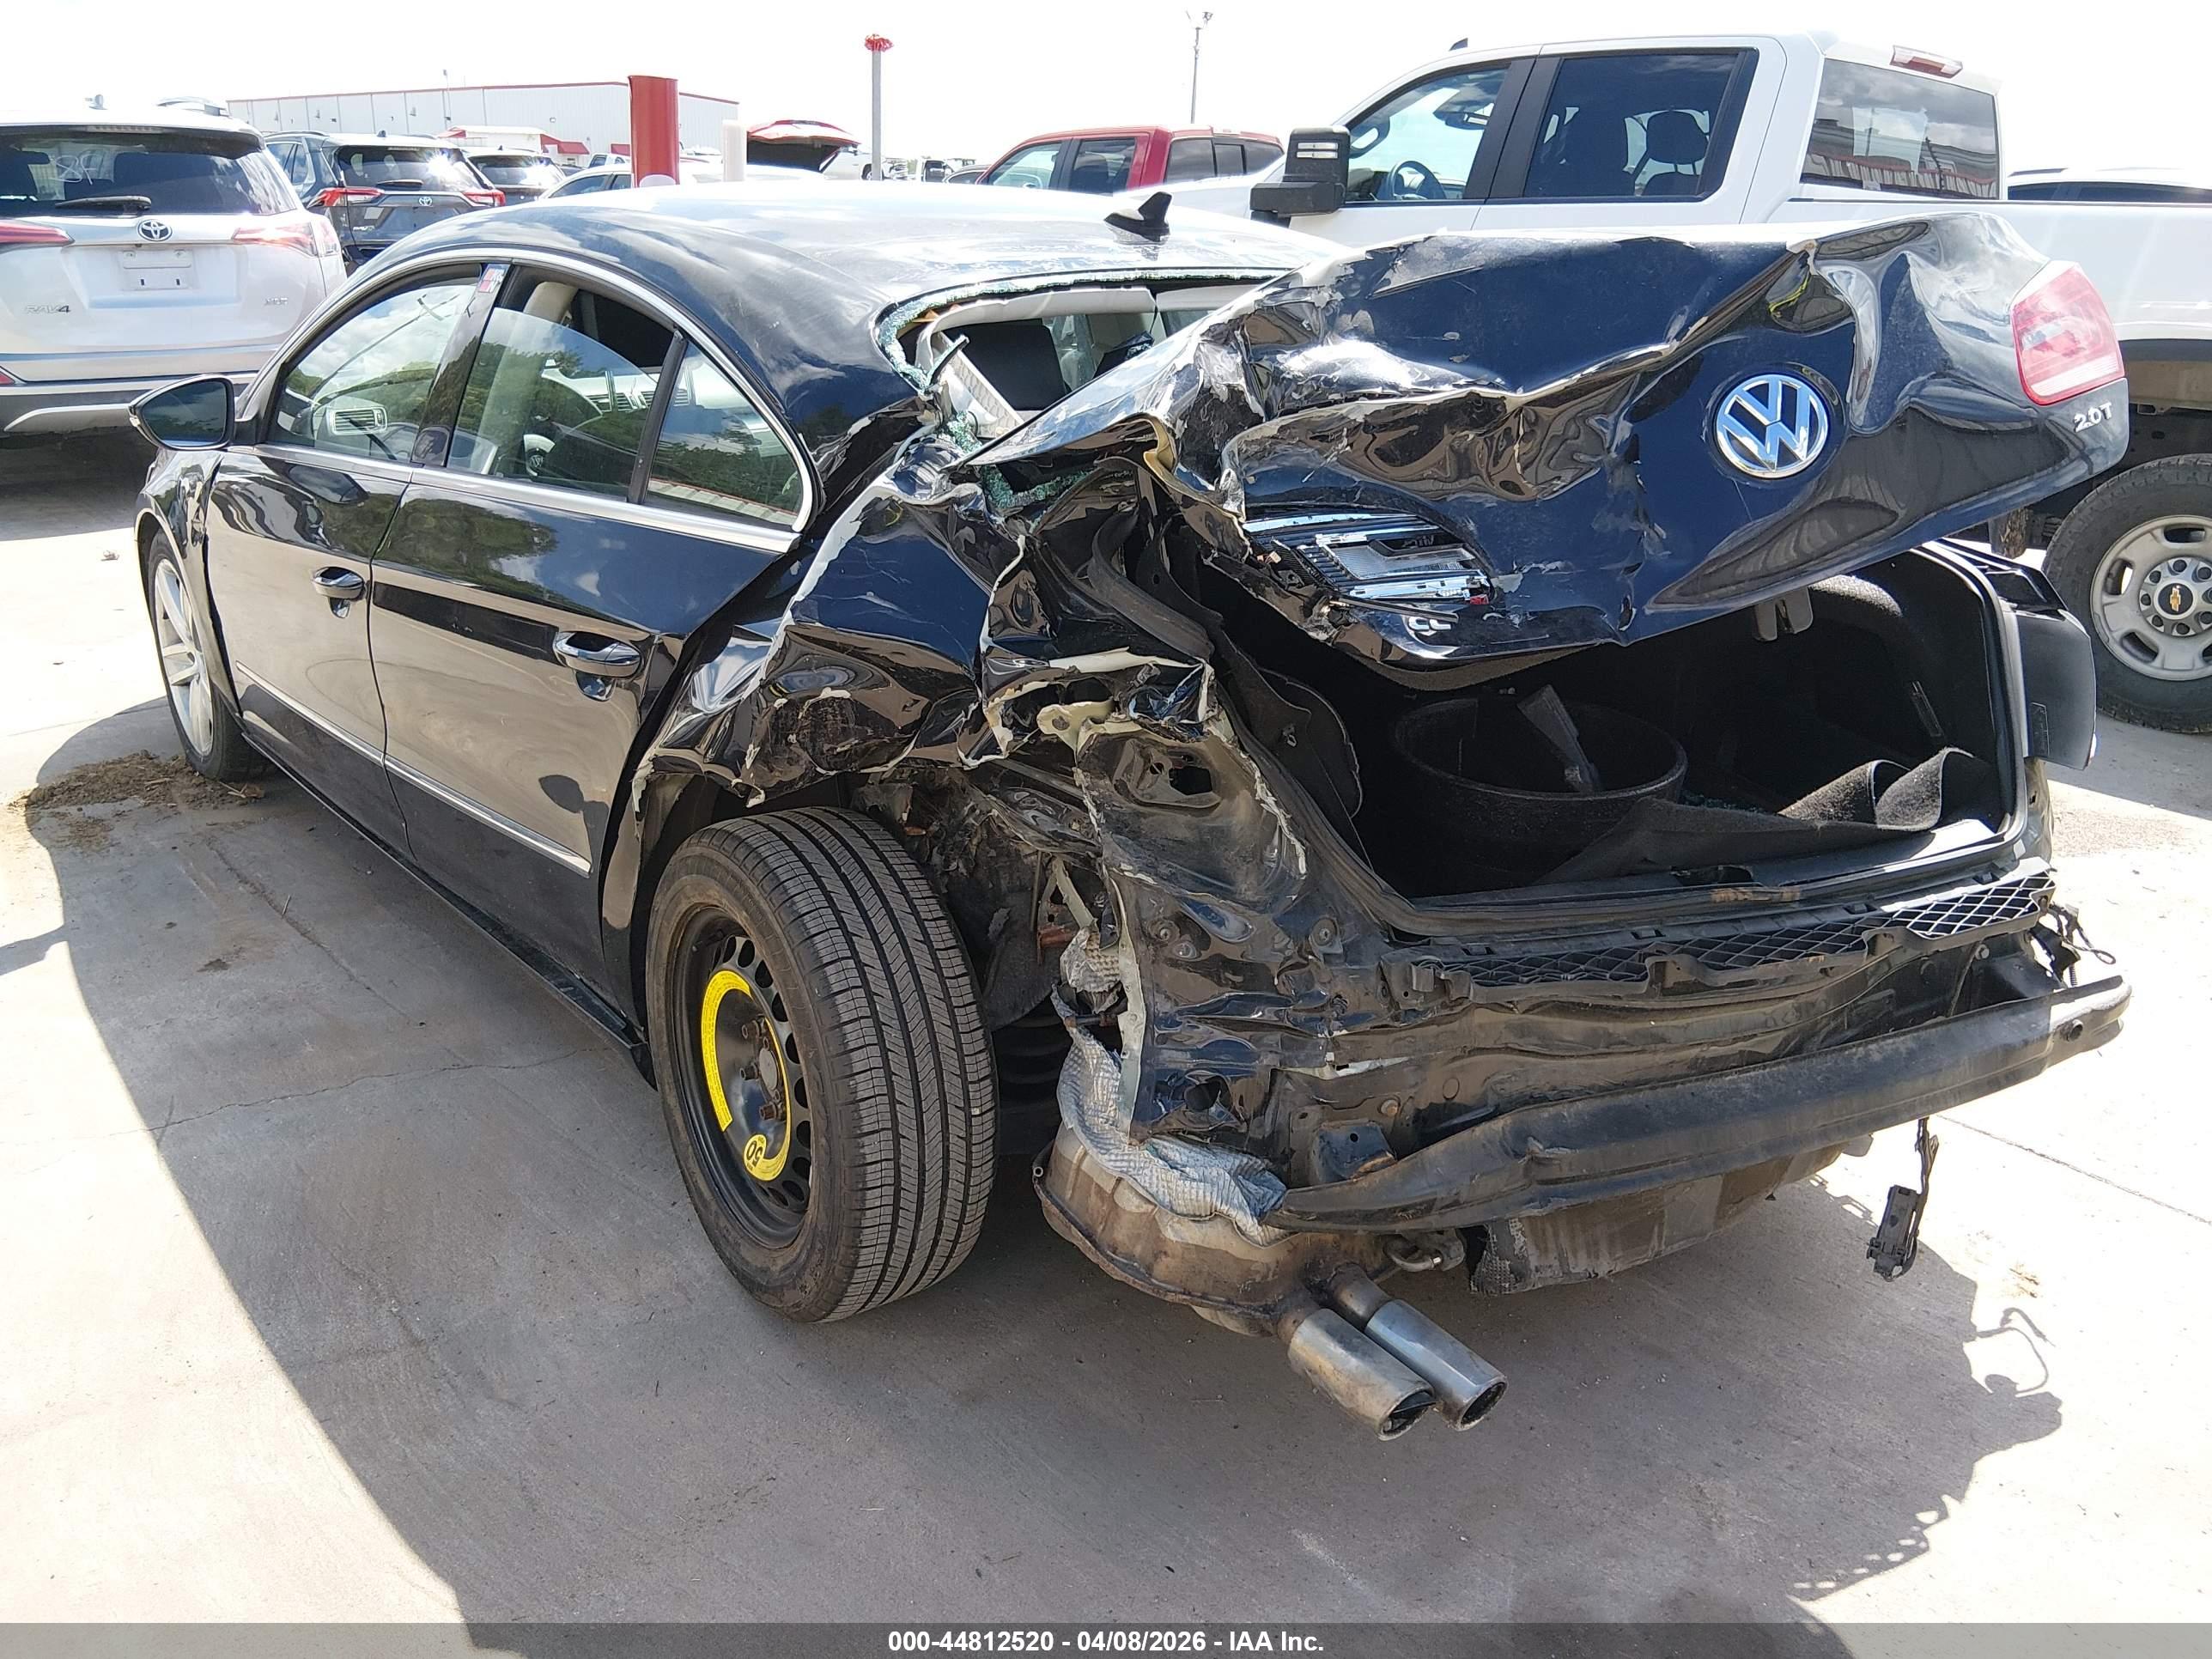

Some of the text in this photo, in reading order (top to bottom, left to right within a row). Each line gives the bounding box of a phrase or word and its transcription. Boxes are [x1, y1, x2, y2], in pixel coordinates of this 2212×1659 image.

[24, 304, 71, 315] RAV4
[1716, 374, 1828, 479] VW
[2073, 401, 2113, 434] 2.0T
